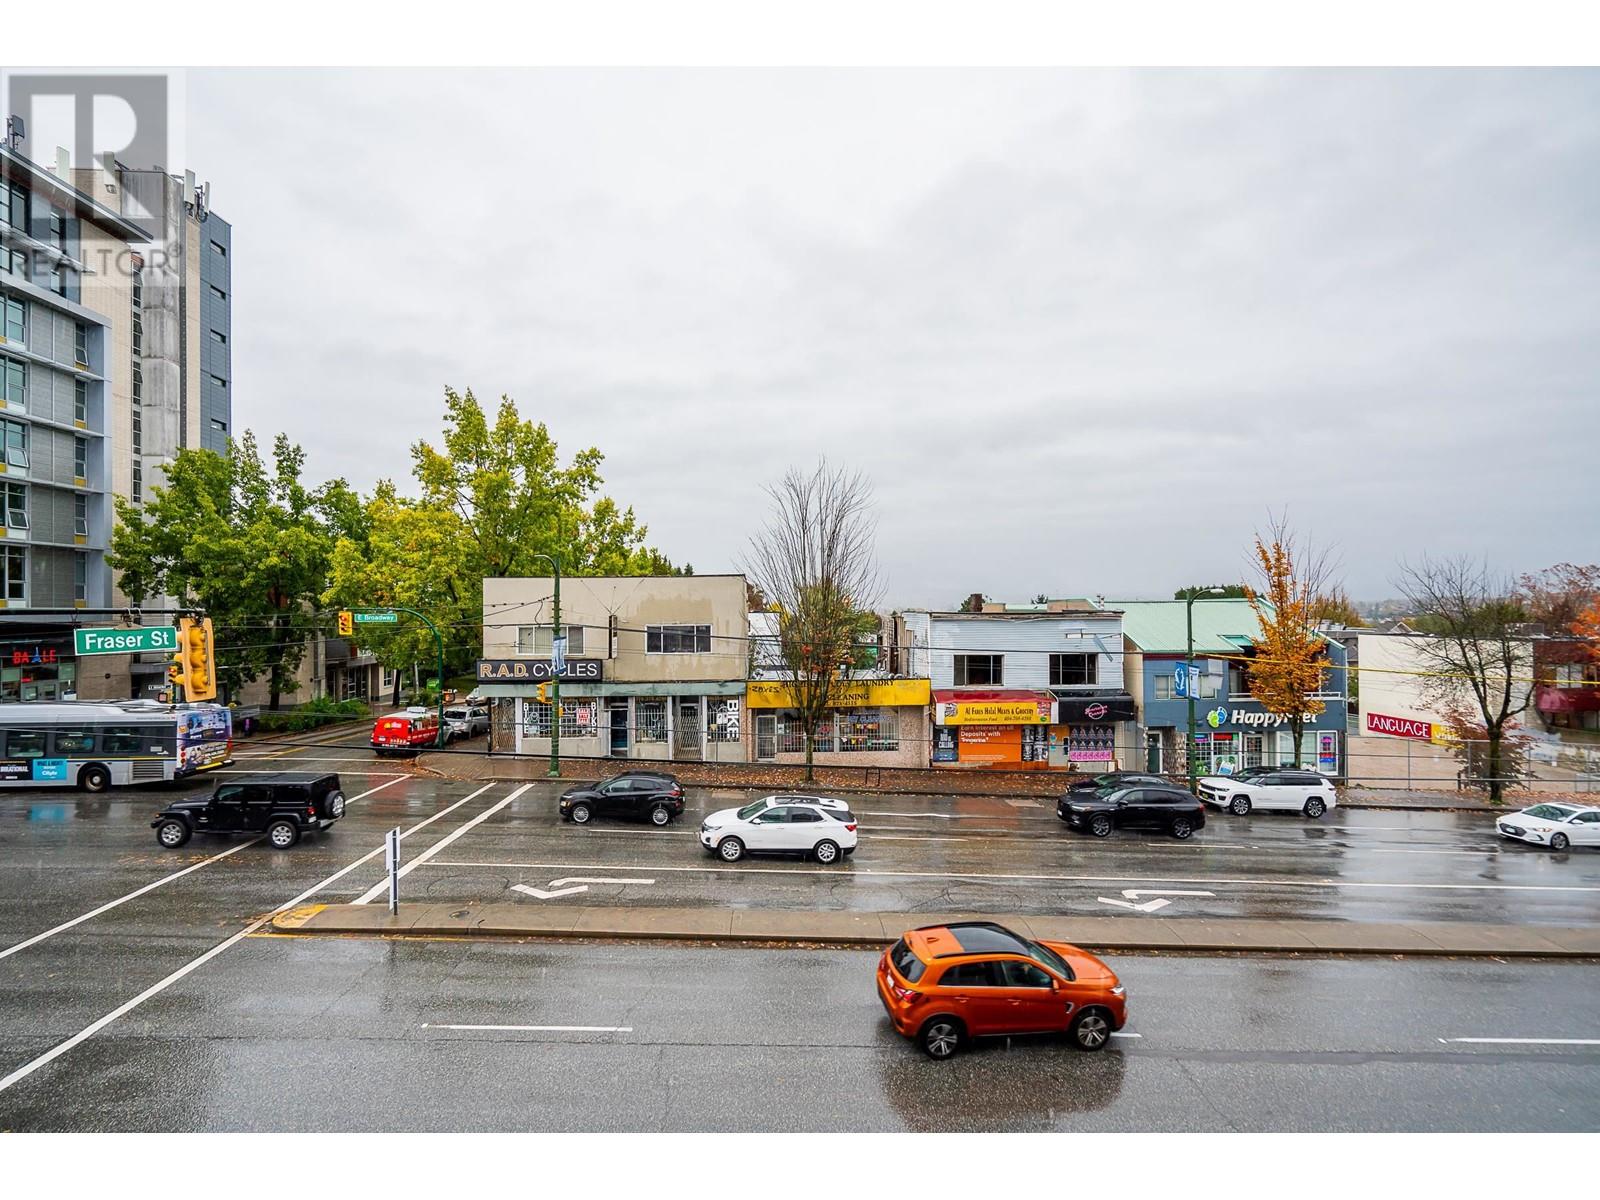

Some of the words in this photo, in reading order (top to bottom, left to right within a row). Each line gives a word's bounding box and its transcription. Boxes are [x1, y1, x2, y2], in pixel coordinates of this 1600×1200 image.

[85, 633, 143, 650] Fraser
[151, 630, 169, 646] St
[480, 663, 529, 678] R.A.D.
[727, 700, 739, 739] BIKE
[1367, 715, 1430, 737] LANGUAGE
